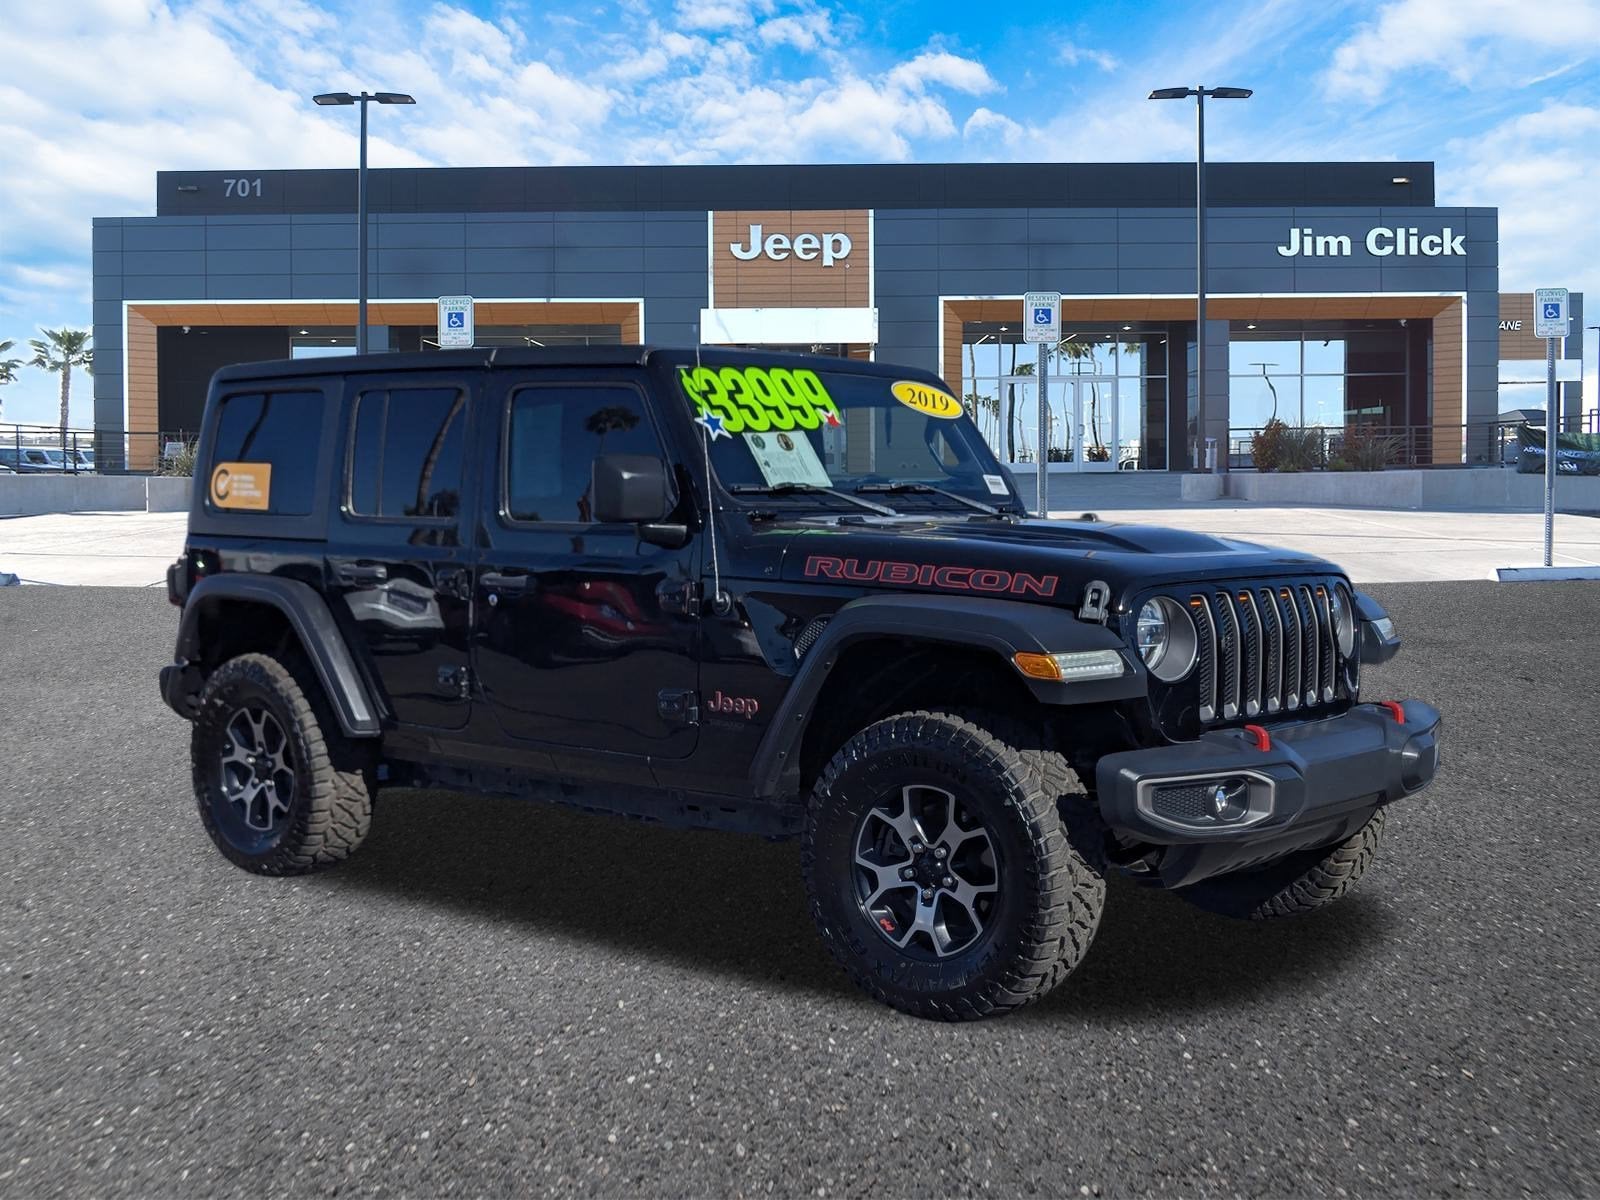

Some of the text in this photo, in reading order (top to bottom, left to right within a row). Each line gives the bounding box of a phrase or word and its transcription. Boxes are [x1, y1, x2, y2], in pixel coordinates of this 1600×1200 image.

[223, 178, 262, 198] 701
[729, 223, 852, 267] Jeep
[1277, 226, 1467, 257] Jim Click
[1027, 294, 1058, 302] RESERVED
[679, 366, 840, 432] $33999
[907, 387, 949, 411] 2019
[804, 555, 1058, 597] RUBICON
[707, 690, 759, 720] Jeep
